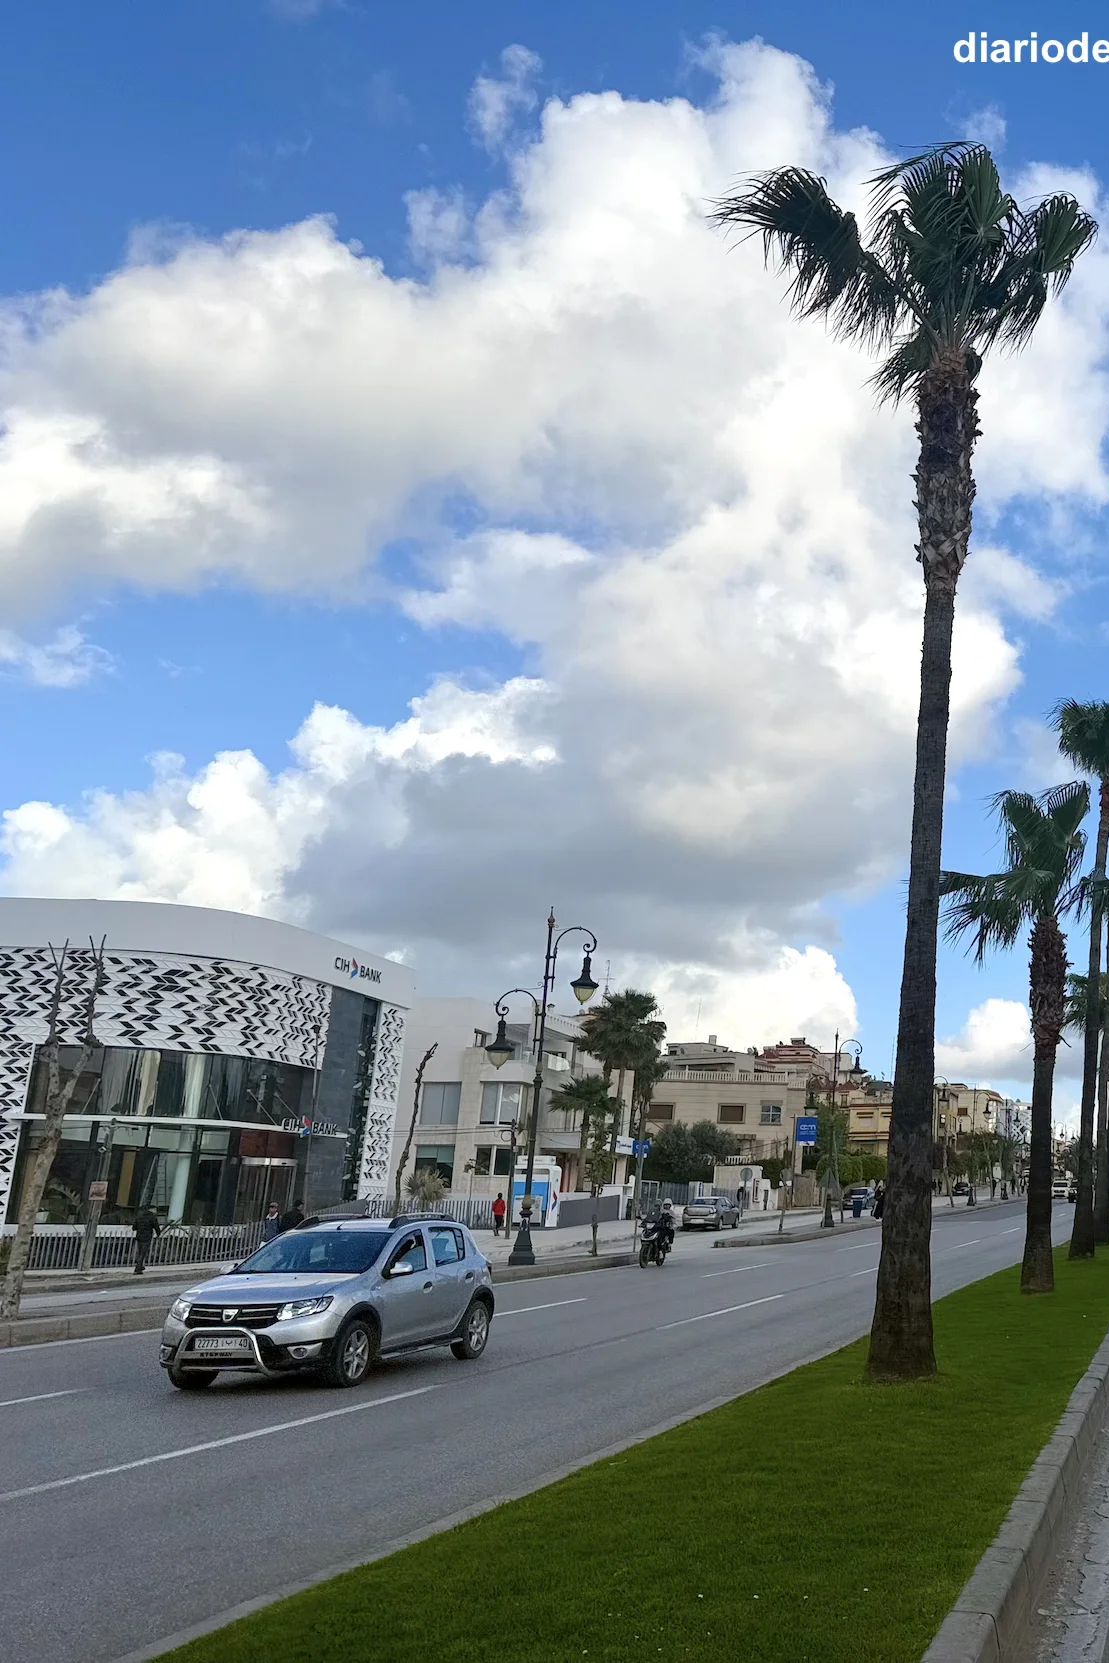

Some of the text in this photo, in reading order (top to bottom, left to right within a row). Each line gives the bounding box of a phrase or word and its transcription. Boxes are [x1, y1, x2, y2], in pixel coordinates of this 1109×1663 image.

[334, 957, 382, 984] CIH BANK
[281, 1118, 337, 1135] CIH BANK
[197, 1338, 219, 1348] 22773
